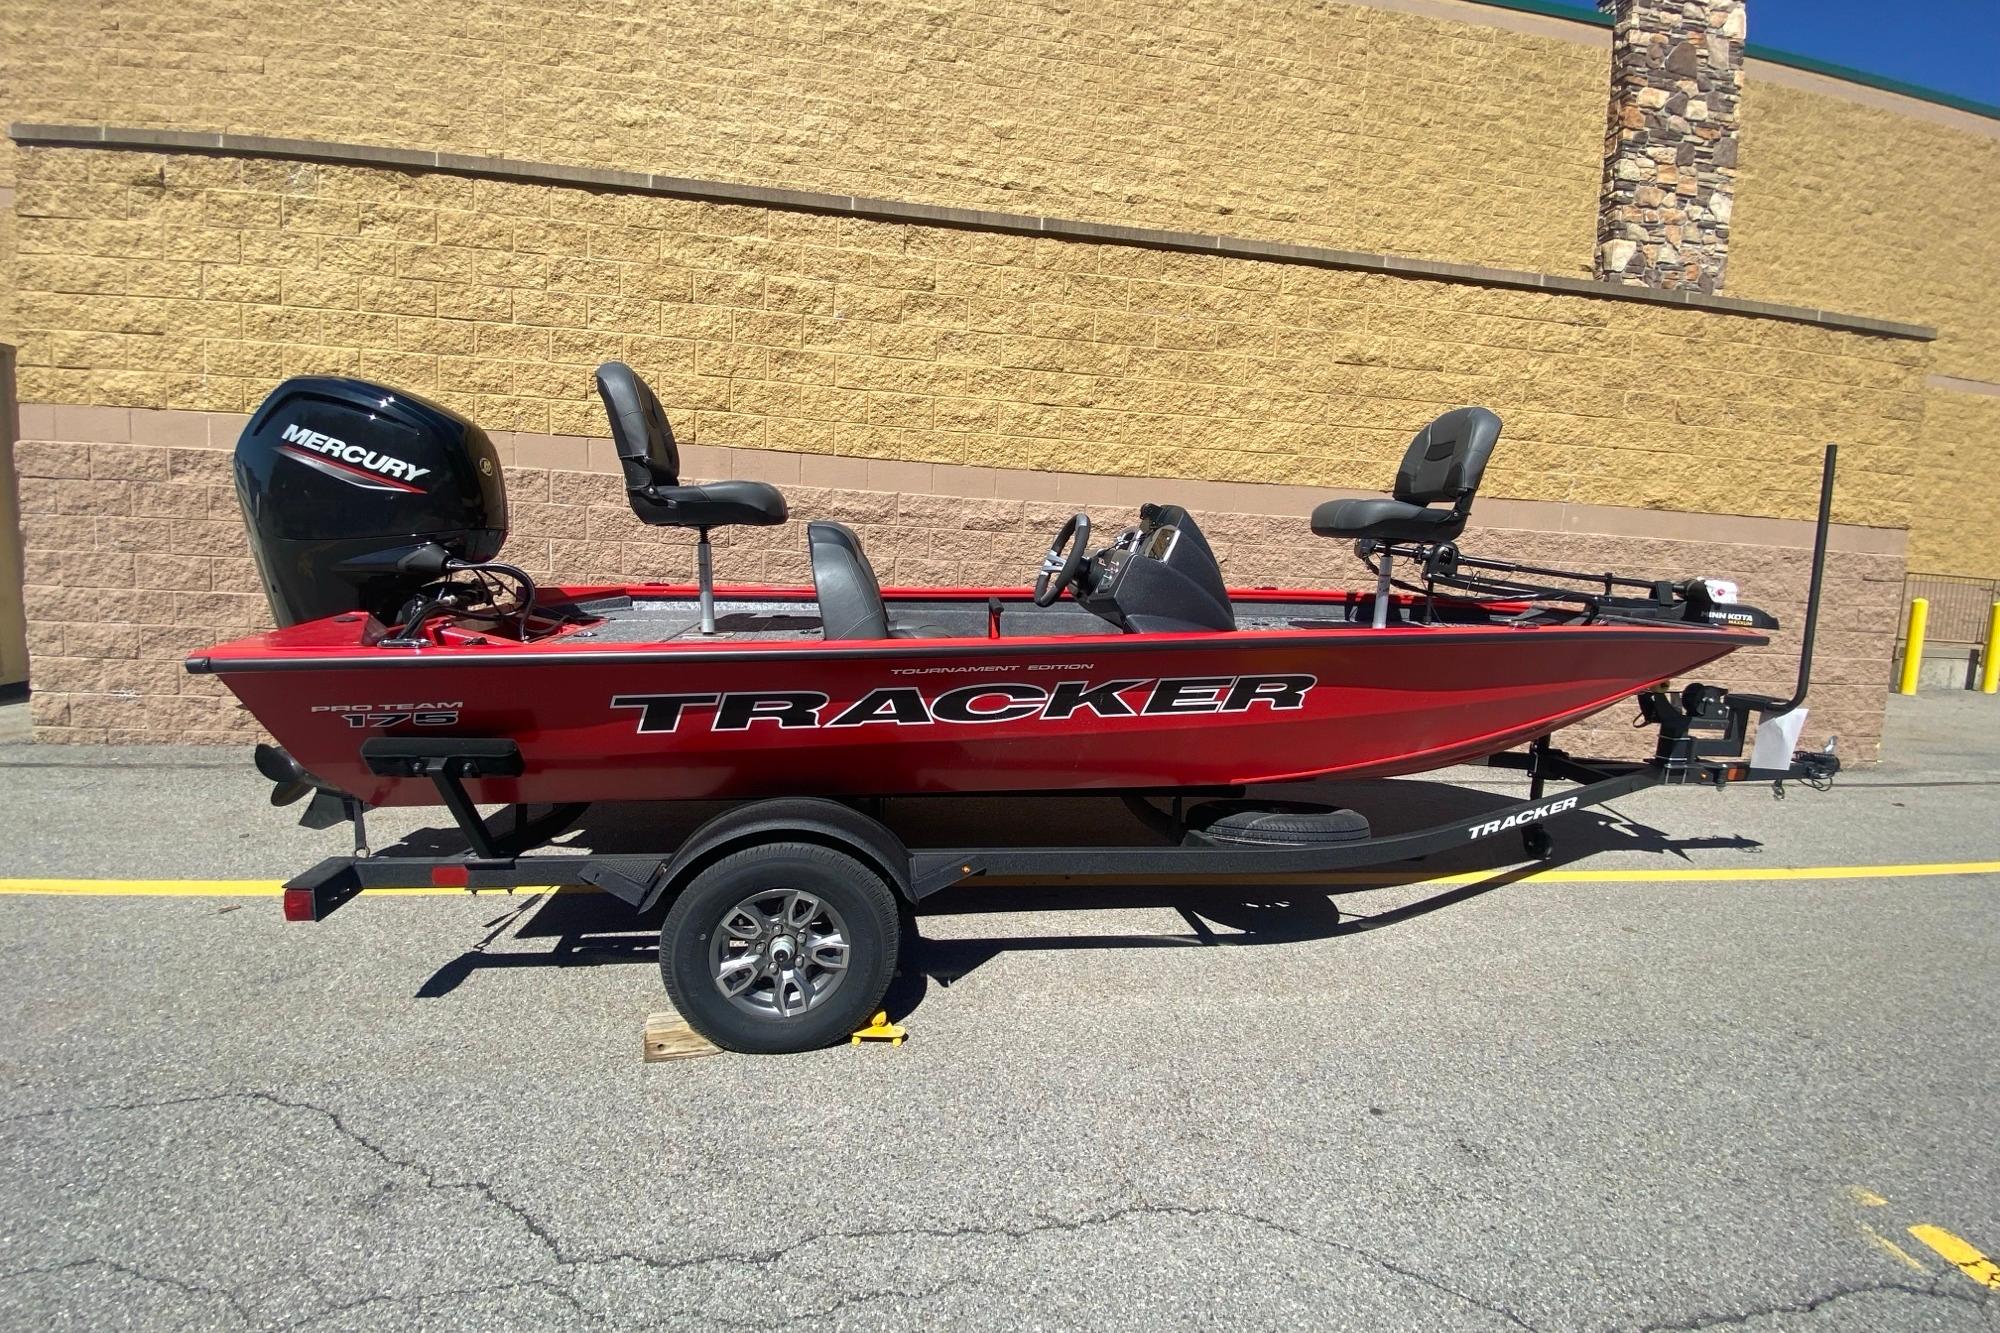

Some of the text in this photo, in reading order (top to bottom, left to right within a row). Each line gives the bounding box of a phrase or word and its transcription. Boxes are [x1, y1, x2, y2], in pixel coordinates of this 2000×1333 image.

[281, 423, 432, 482] MERCURY
[1727, 613, 1753, 621] KOTA
[890, 663, 1095, 675] TOURNAMENT EDITION
[311, 701, 464, 713] PRO TEAM
[610, 673, 1317, 733] TRACKER
[340, 710, 460, 729] 175
[1468, 796, 1579, 840] TRACKER
